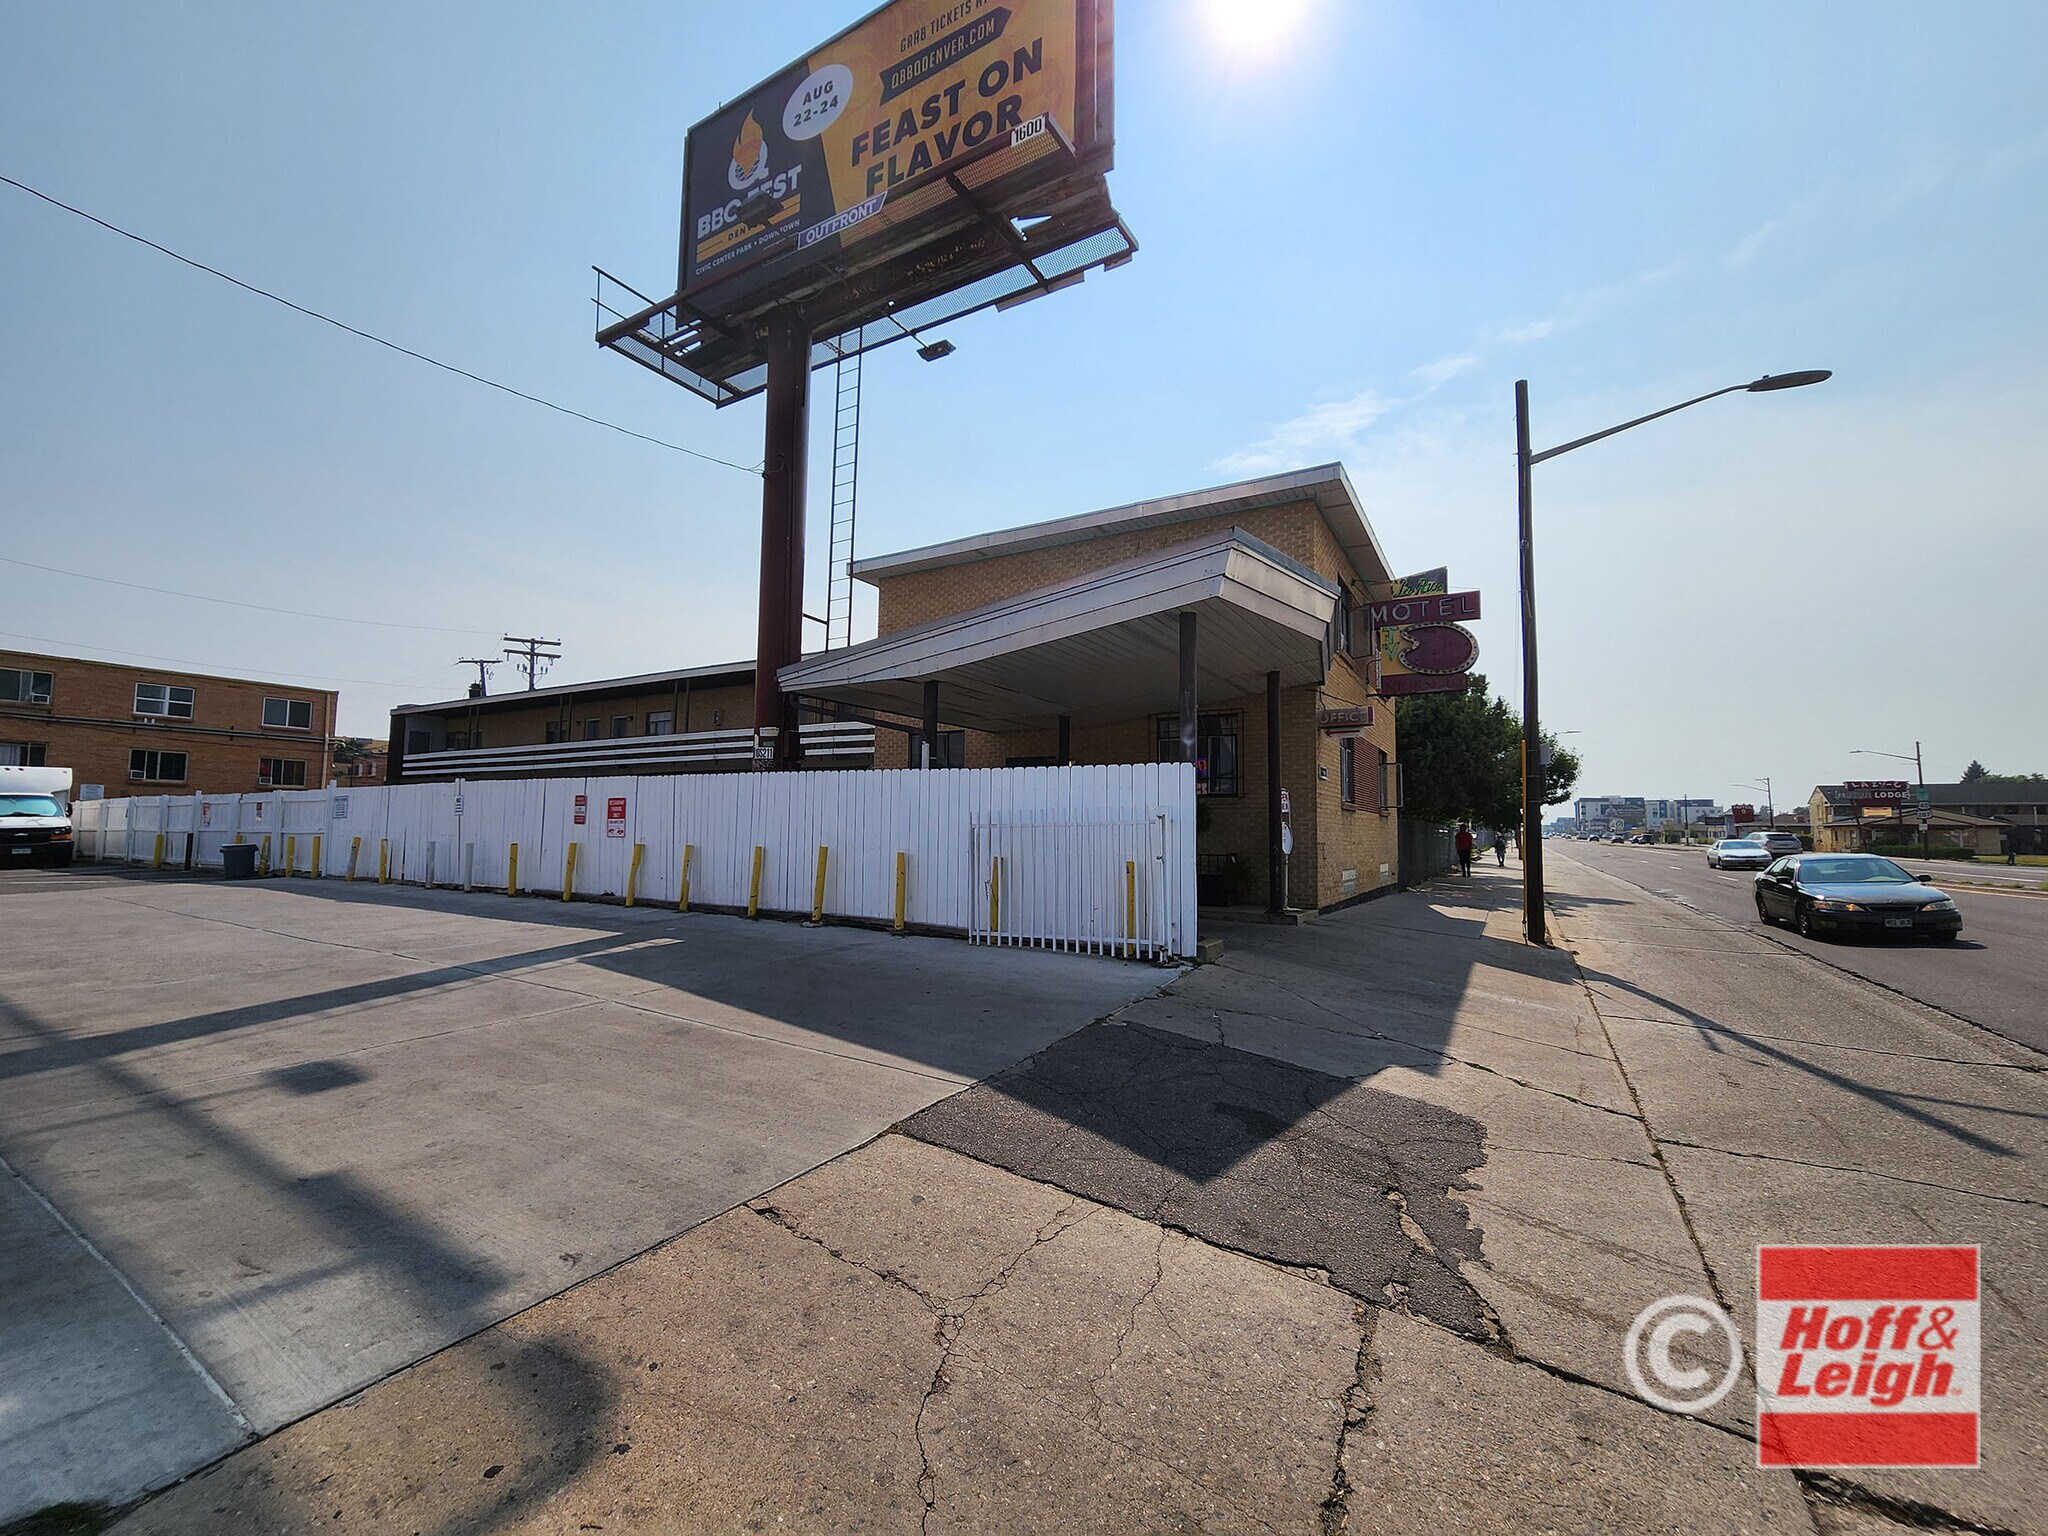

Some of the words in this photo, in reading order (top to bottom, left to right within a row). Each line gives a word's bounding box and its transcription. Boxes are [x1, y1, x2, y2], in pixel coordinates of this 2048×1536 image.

[901, 25, 926, 52] GRAB
[930, 0, 971, 34] TICKETS
[802, 80, 834, 106] AUG
[852, 79, 966, 167] FEAST
[978, 37, 1043, 98] ON
[793, 95, 839, 127] 22-24
[1015, 118, 1042, 143] 1600
[867, 94, 1024, 198] FLAVOR
[806, 200, 877, 244] OUTFRONT
[695, 262, 712, 275] CIVIC
[712, 250, 735, 267] CENTER
[736, 243, 753, 255] PARK
[1393, 578, 1412, 598] La
[1371, 597, 1476, 623] MOTEL
[1319, 711, 1366, 724] OFFICE
[1874, 791, 1907, 799] LODGE
